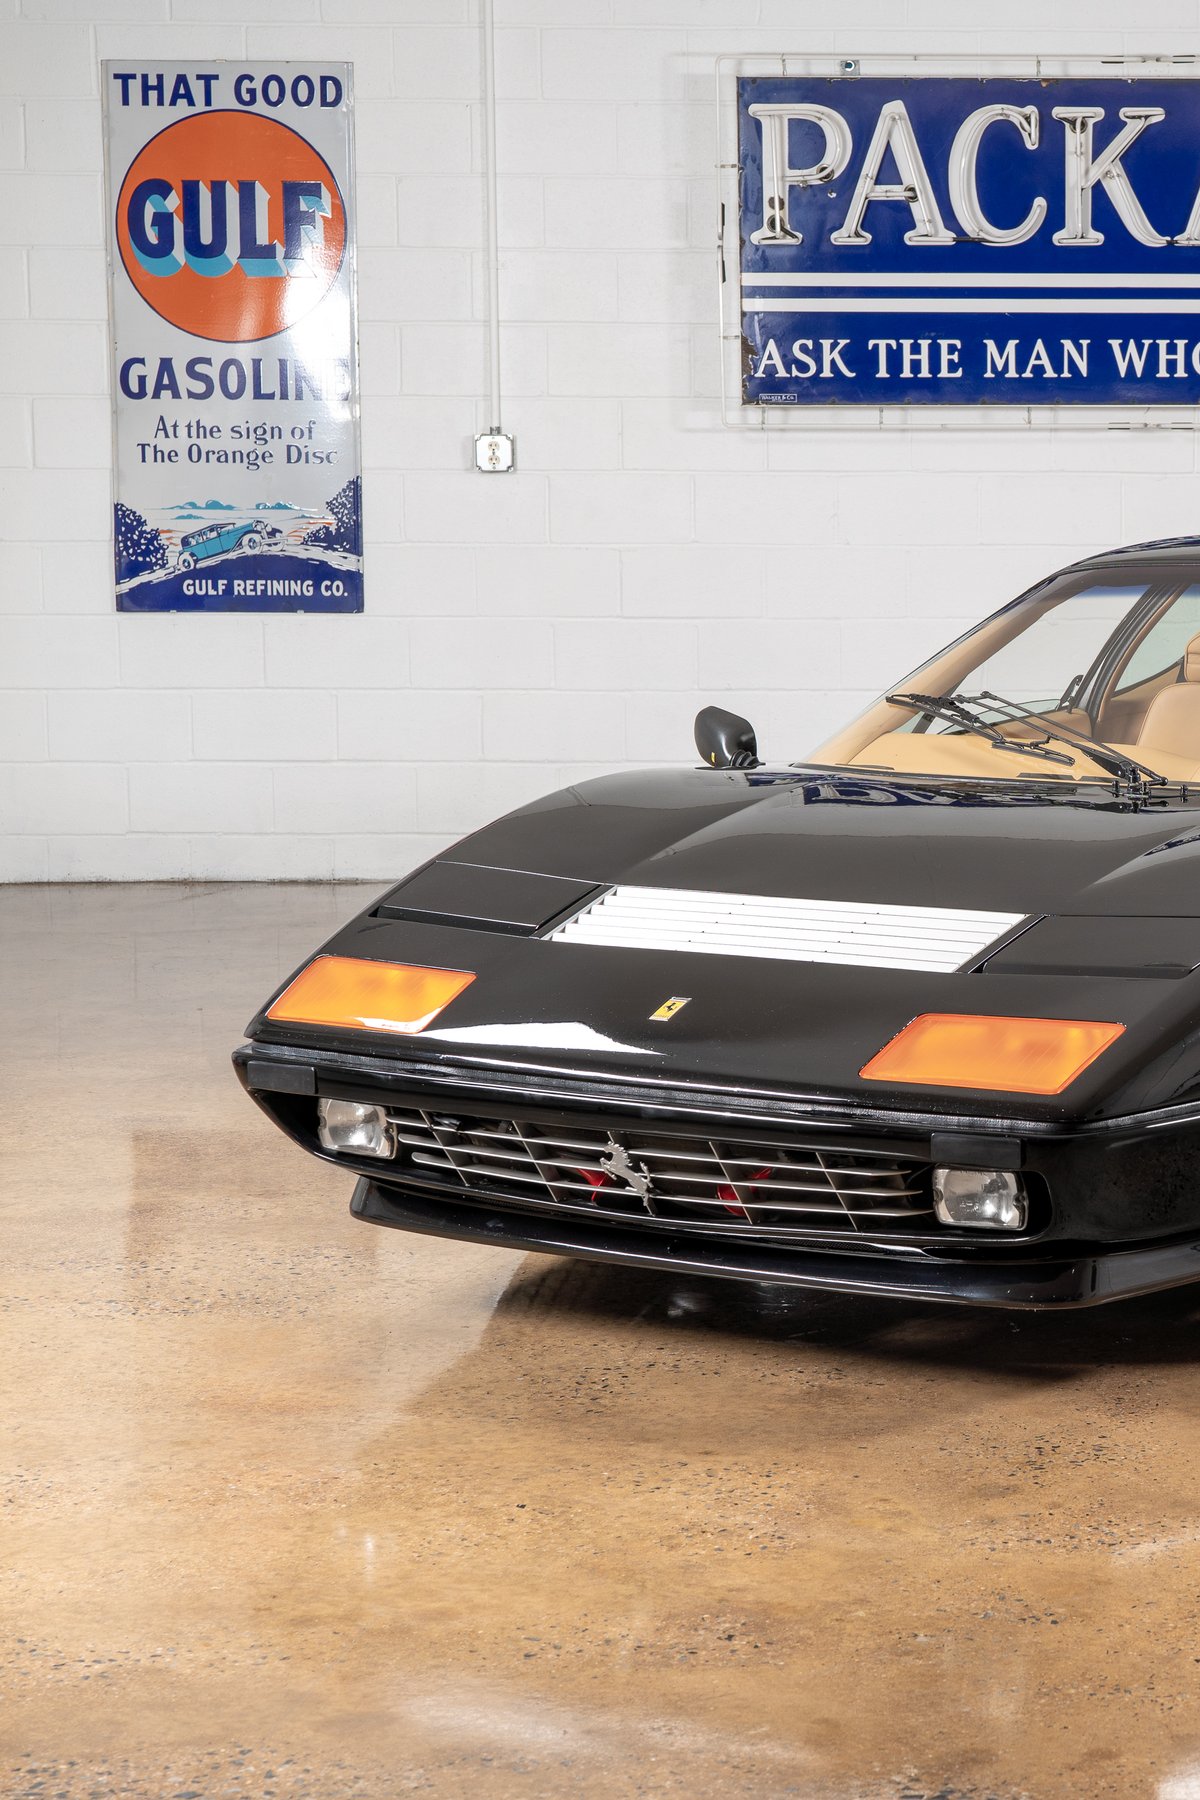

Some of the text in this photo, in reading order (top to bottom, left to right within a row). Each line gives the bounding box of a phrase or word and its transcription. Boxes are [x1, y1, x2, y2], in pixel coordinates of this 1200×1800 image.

[113, 73, 343, 108] THAT GOOD
[127, 178, 331, 277] GULF
[754, 338, 856, 378] ASK
[868, 339, 963, 378] THE
[983, 339, 1091, 378] MAN
[154, 415, 316, 445] At the sign of
[137, 443, 339, 470] The Orange Disc
[183, 579, 348, 597] GULF REFINING CO.
